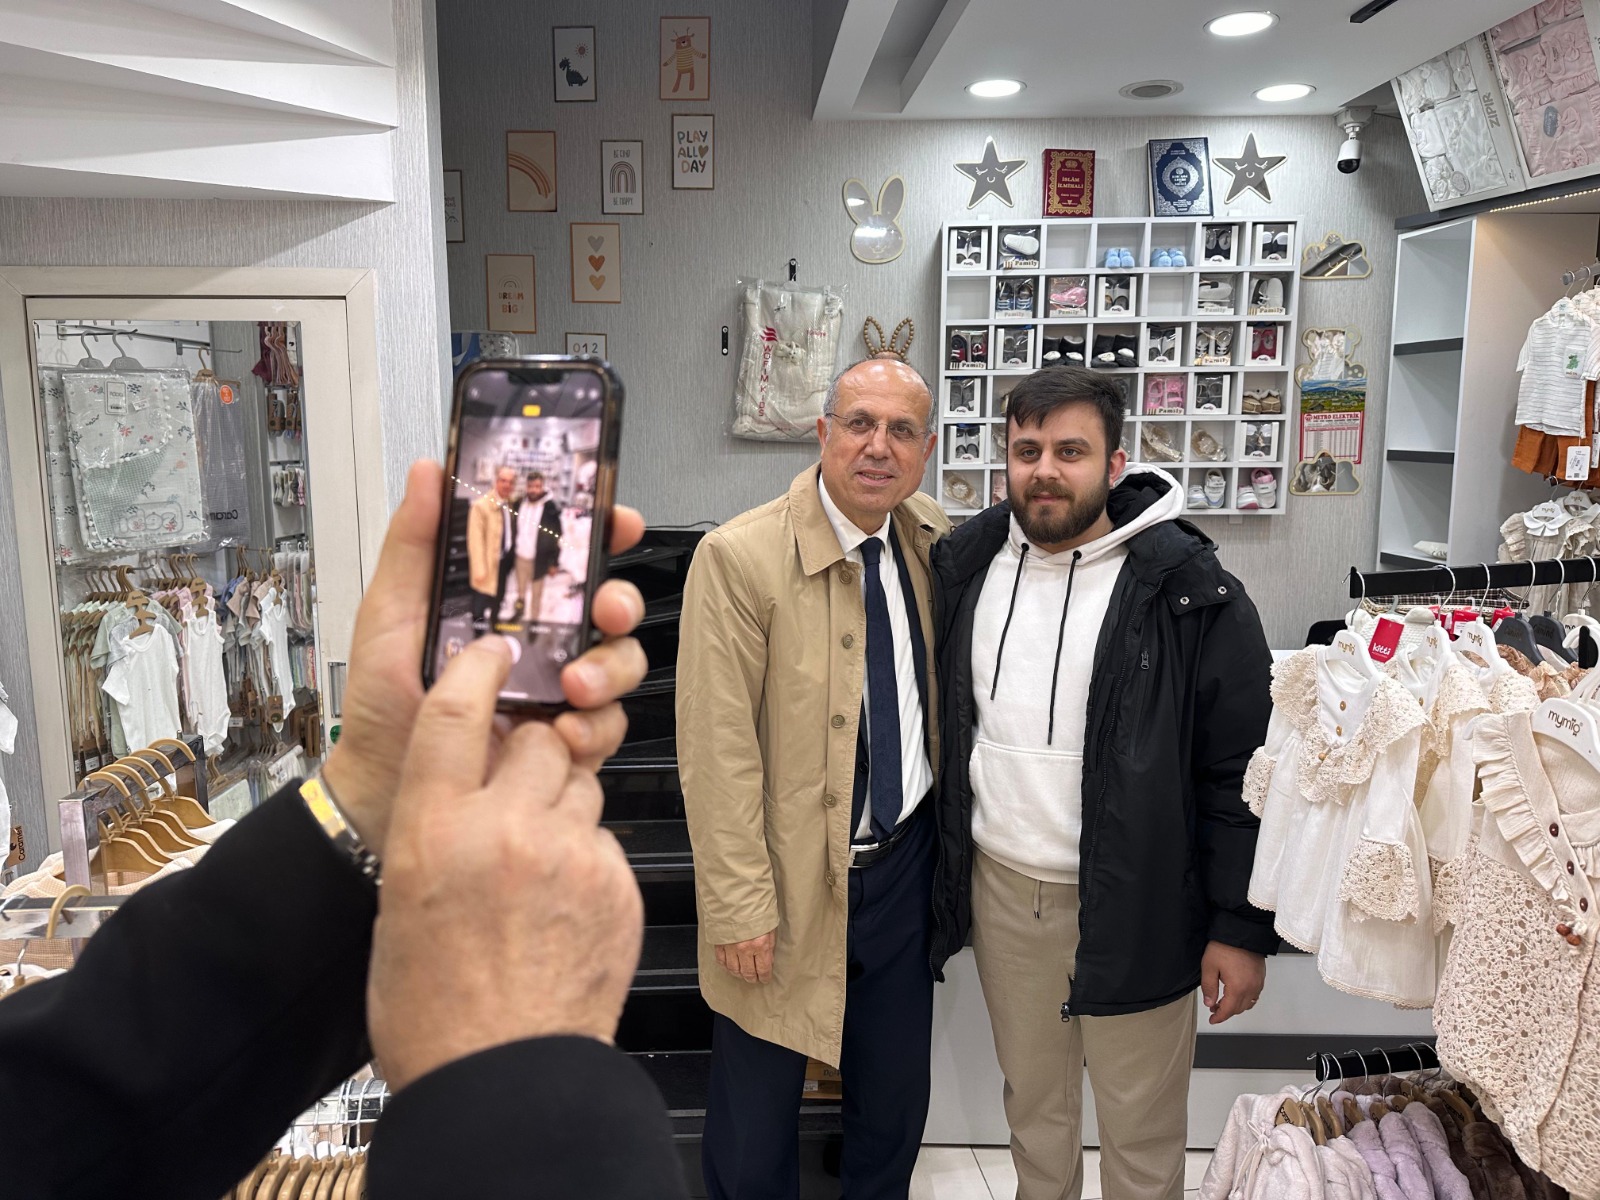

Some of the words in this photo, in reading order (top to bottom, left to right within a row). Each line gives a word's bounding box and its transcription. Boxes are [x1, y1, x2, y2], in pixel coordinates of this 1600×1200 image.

[677, 130, 708, 144] PLAY
[677, 146, 698, 158] ALL
[681, 159, 707, 173] DAY
[498, 292, 524, 300] DREAM
[1372, 642, 1391, 656] kitti
